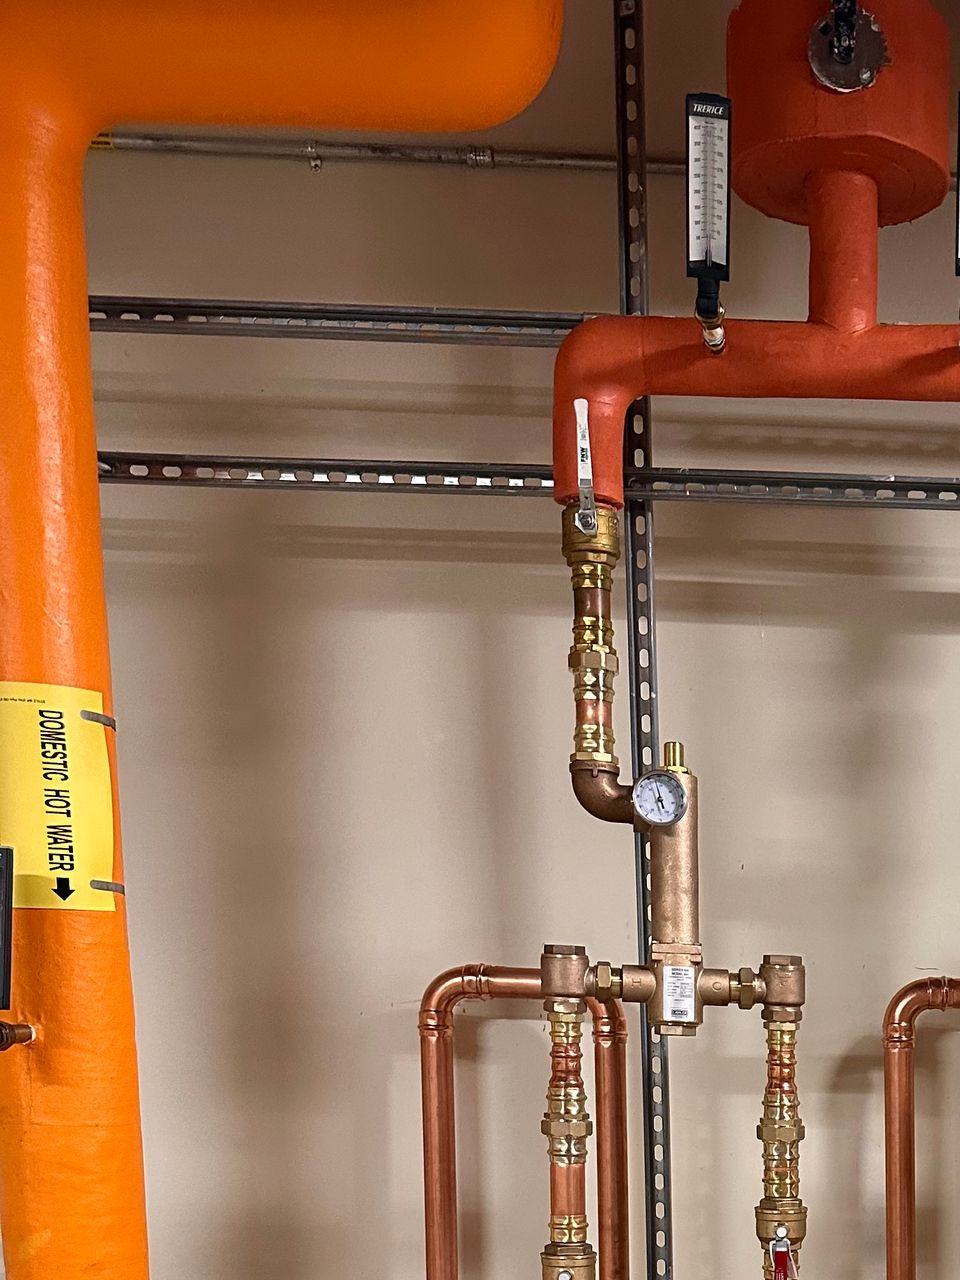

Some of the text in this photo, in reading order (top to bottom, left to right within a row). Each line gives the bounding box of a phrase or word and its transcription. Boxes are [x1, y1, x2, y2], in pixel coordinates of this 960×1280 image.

[693, 103, 724, 115] TRERICE
[38, 709, 75, 872] DOMESTIC HOT WATER
